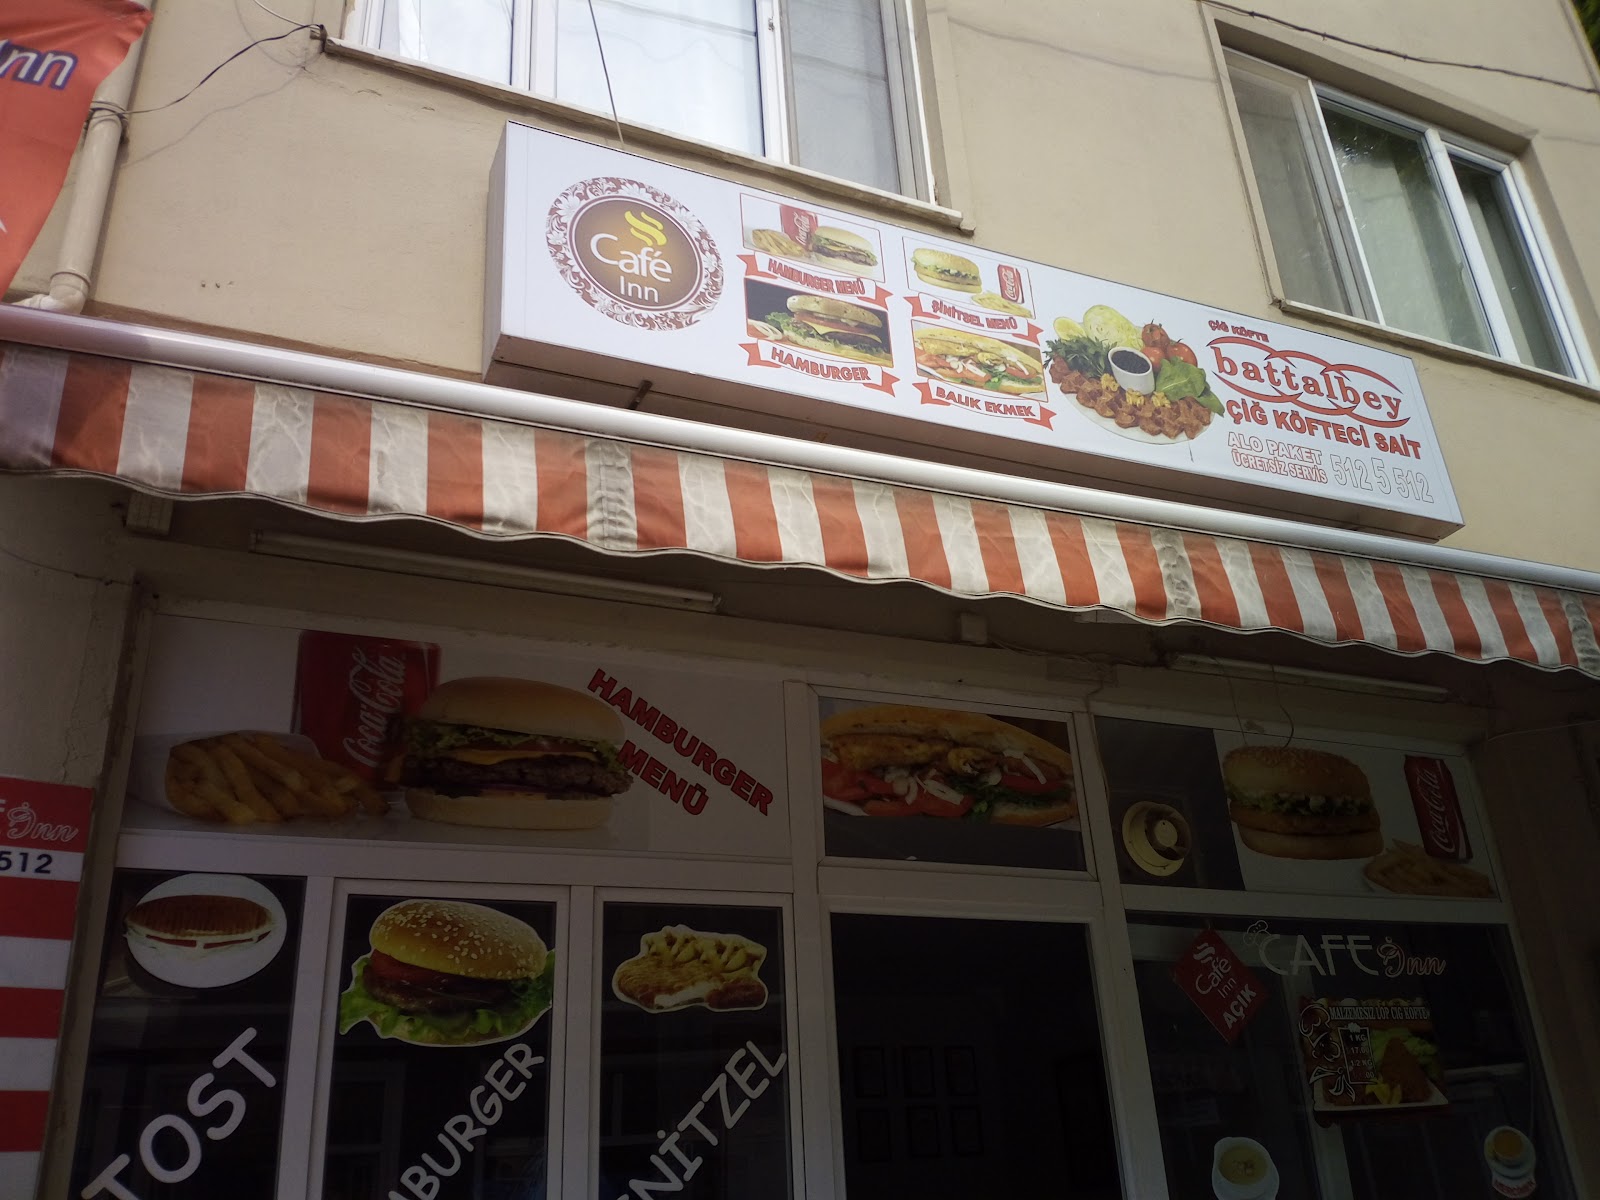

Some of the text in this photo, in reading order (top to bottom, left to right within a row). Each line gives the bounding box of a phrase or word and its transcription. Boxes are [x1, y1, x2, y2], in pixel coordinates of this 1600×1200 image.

[0, 37, 76, 88] nn
[590, 233, 672, 282] Café
[768, 258, 866, 295] HAMBURGER MENÜ
[620, 275, 658, 303] Inn
[986, 316, 1018, 330] MENÜ
[771, 347, 871, 381] HAMBURGER
[1210, 346, 1402, 419] battalbey
[936, 386, 1036, 417] BALIK EKMEK
[1226, 398, 1421, 460] ÇİĞ KÖFTECİ SAİT
[1228, 432, 1322, 465] ALO PAKET
[1232, 449, 1328, 484] ÜCRETSİZ SERVİS
[1330, 454, 1434, 504] 512 5 512
[587, 668, 774, 816] HAMBURGER
[617, 740, 709, 816] MENÜ
[1195, 957, 1231, 994] Café
[1257, 933, 1379, 976] CAFE
[1223, 984, 1256, 1029] AÇIK
[81, 1027, 277, 1200] TOST
[388, 1043, 545, 1200] BURGER
[617, 1040, 787, 1200] NİTZEL
